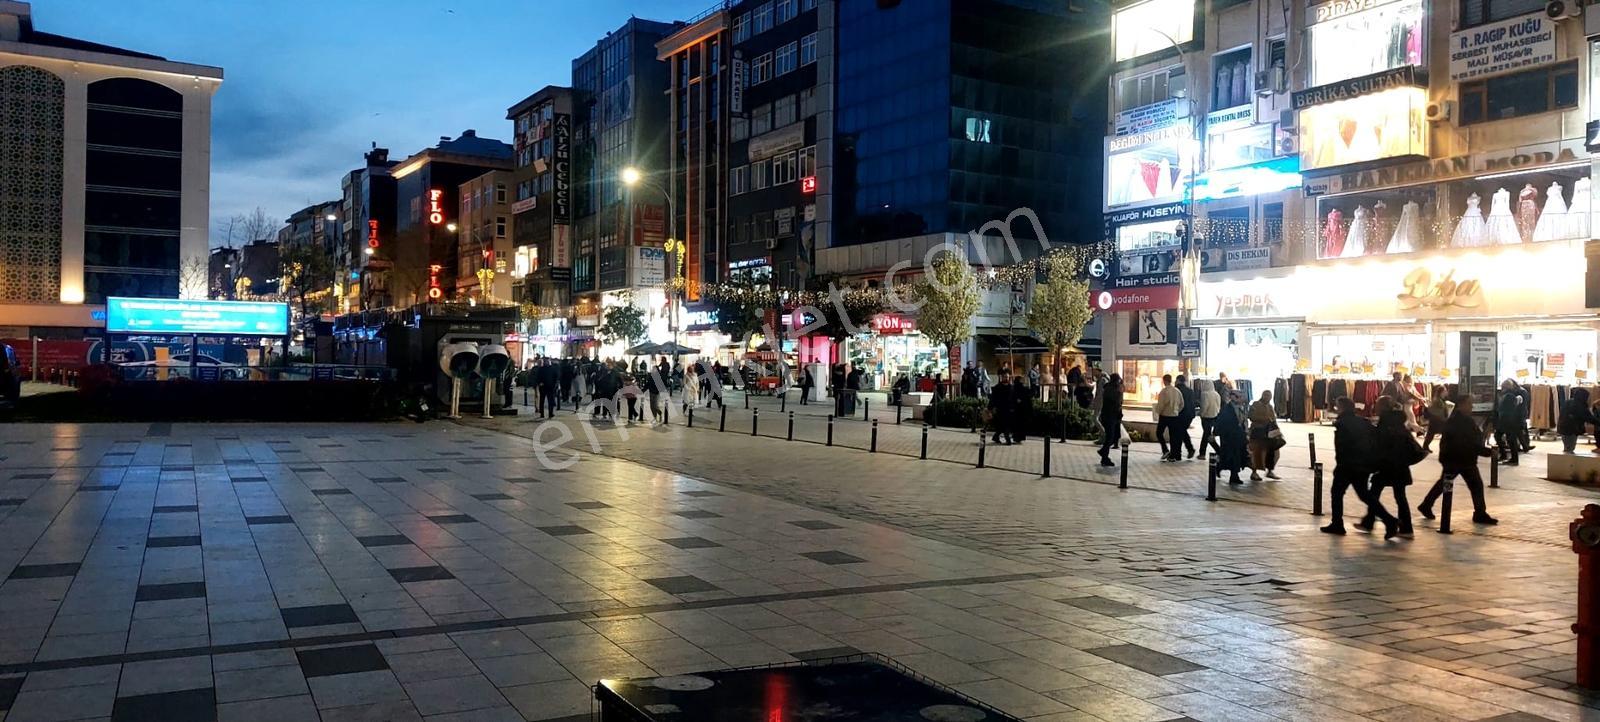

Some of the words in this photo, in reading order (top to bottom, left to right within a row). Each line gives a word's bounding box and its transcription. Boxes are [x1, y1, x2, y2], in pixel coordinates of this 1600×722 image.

[1474, 27, 1506, 46] RAGIP
[1509, 18, 1541, 38] KUĞU
[1451, 47, 1489, 61] SERBEST
[1296, 86, 1346, 107] BERİKA
[1350, 72, 1405, 95] SULTAN
[1485, 148, 1578, 170] MODA
[430, 189, 442, 224] FLO
[1112, 212, 1140, 222] KUAFÖR
[1142, 205, 1185, 218] HÜSEYİN
[430, 264, 442, 298] FLO
[1115, 278, 1139, 288] Hair
[1142, 275, 1180, 285] studio
[1113, 294, 1150, 304] vodafone
[876, 316, 899, 329] YÖN
